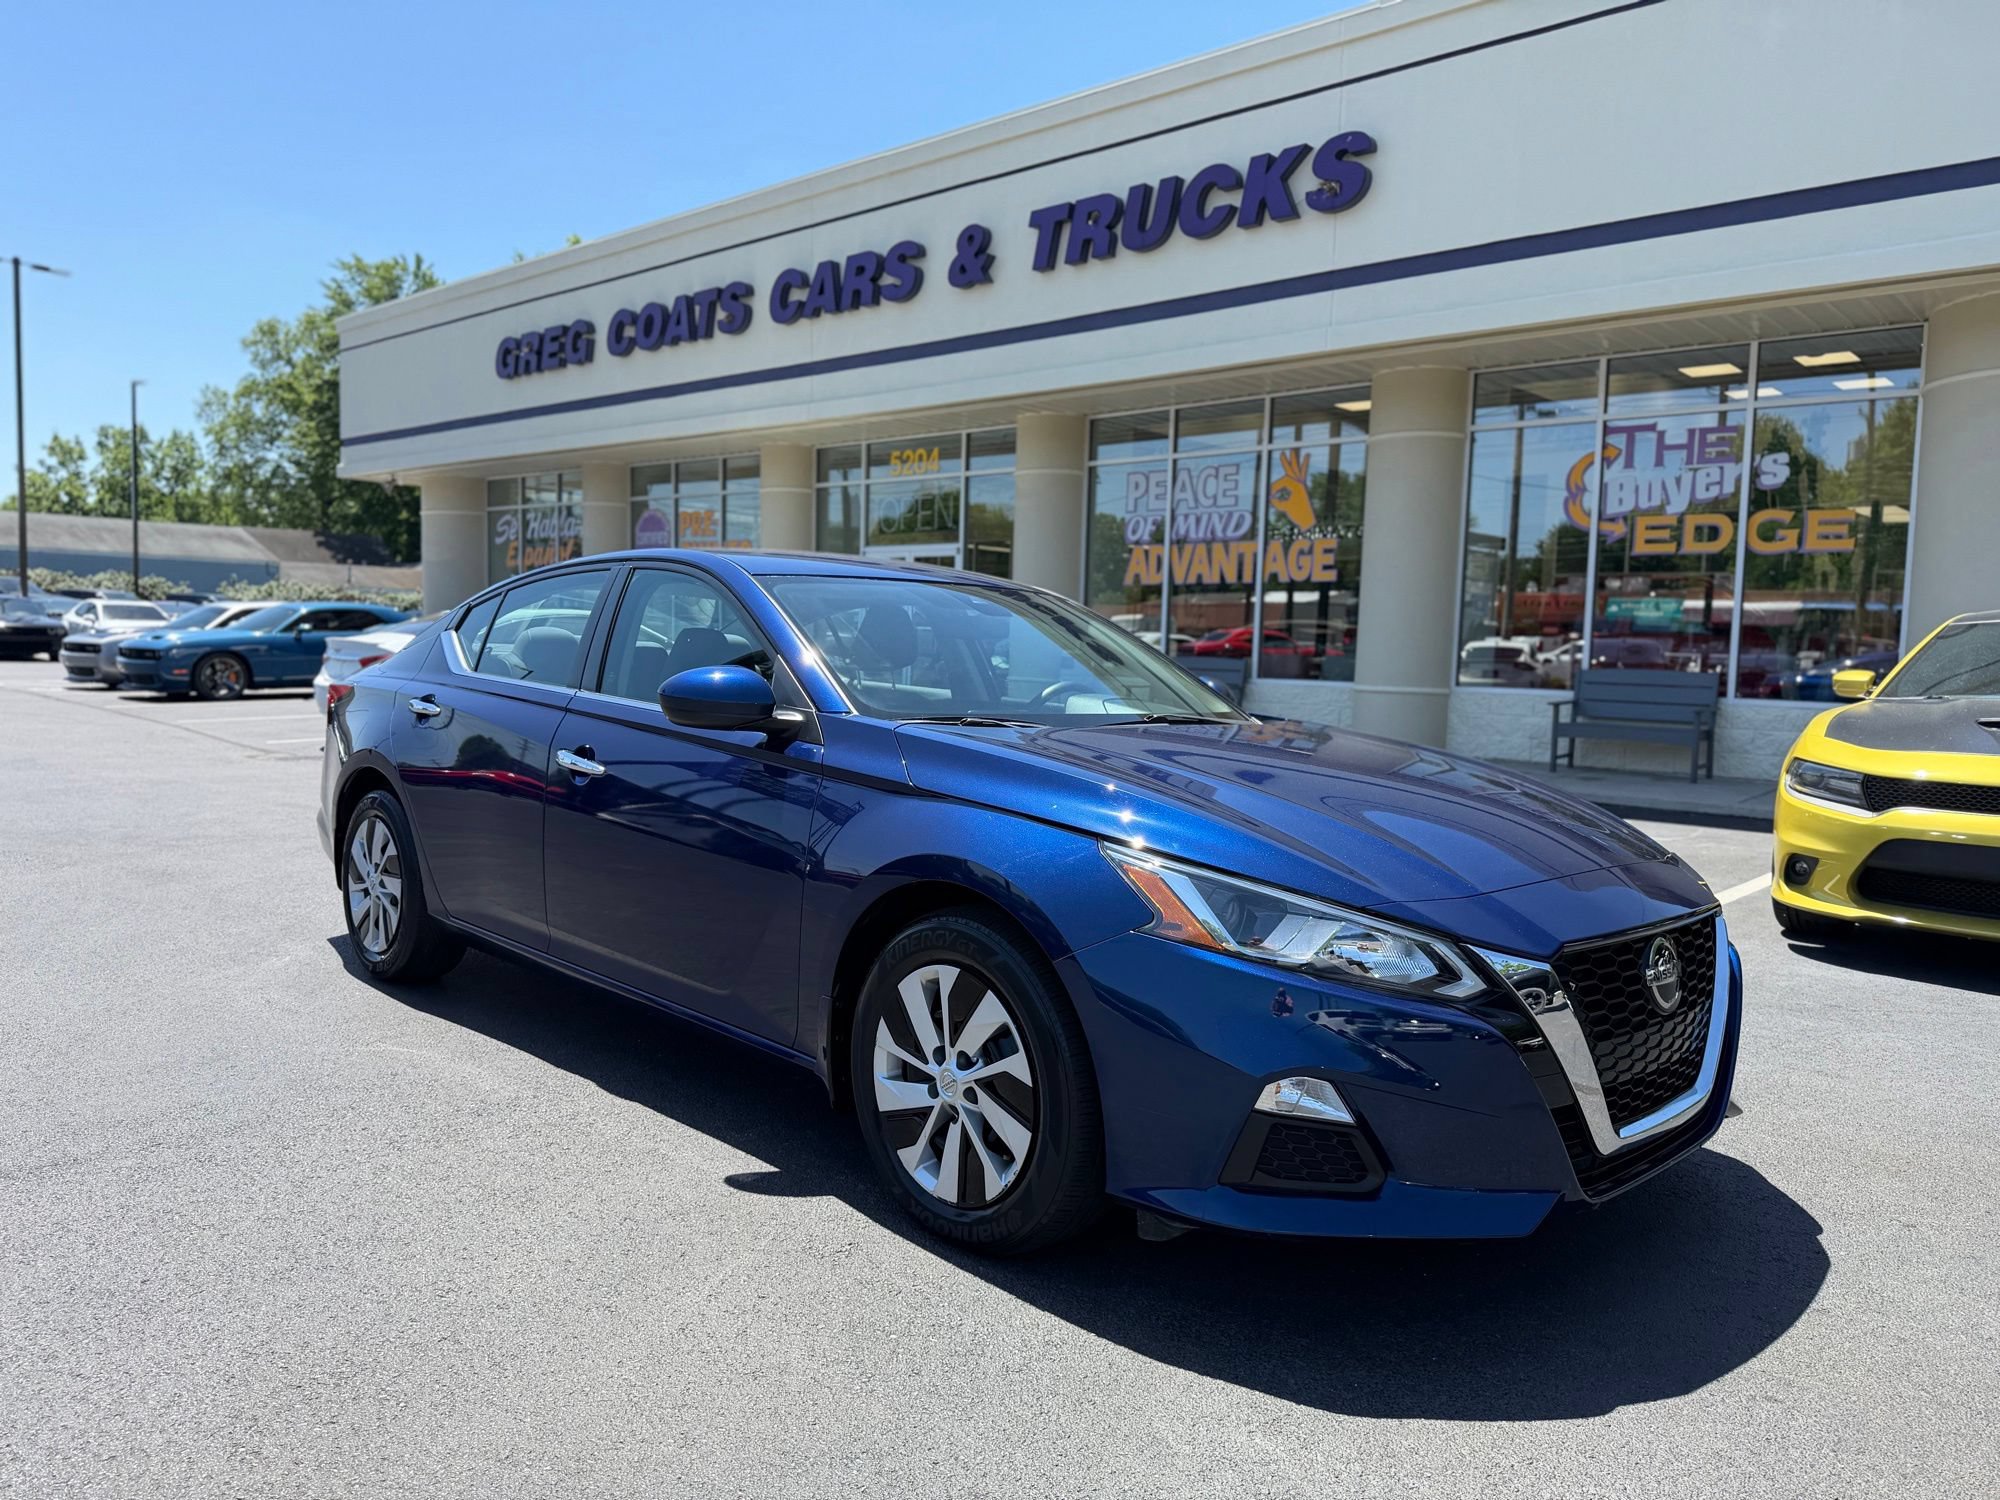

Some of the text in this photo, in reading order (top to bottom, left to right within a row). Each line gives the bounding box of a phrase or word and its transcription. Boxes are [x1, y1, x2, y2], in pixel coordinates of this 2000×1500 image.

[496, 131, 1378, 379] GREG COATS CARS & TRUCKS
[889, 447, 940, 476] 5204
[1604, 422, 1740, 468] THE
[1128, 465, 1240, 512] PEACE
[880, 495, 958, 534] OPEN
[1127, 510, 1254, 542] OF MIND
[1631, 507, 1857, 556] EDGE
[1124, 538, 1338, 585] ADVANTAGE
